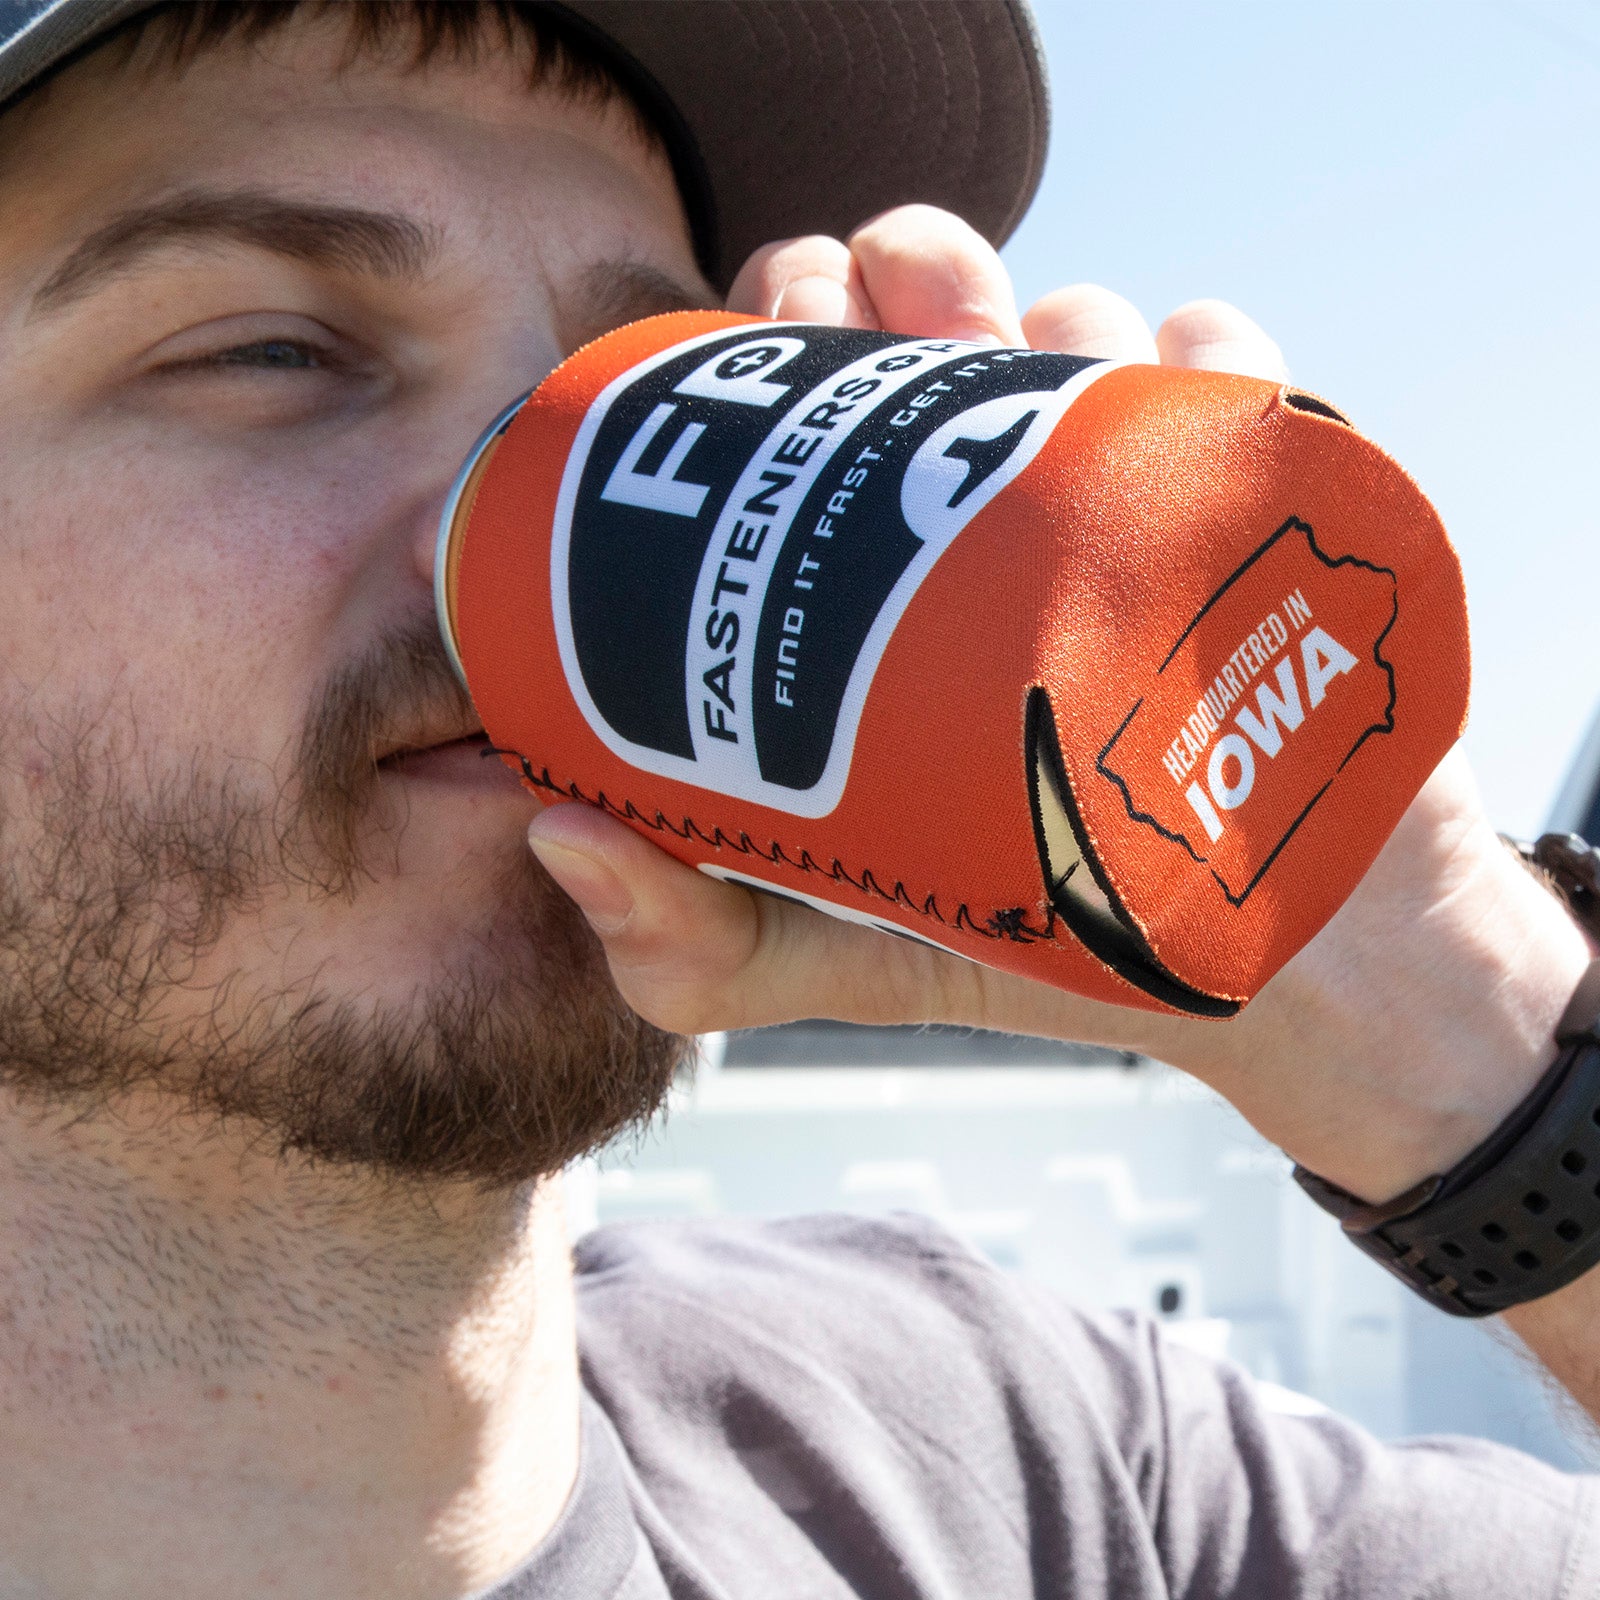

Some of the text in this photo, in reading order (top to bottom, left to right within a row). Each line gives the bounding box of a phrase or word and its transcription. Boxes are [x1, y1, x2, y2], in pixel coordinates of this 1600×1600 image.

[601, 336, 807, 518] FP
[775, 607, 804, 707] FIND
[796, 552, 820, 591] IT
[890, 380, 952, 427] GET
[954, 362, 989, 377] IT
[702, 378, 883, 744] FASTENERS
[1162, 589, 1313, 785] HEADQUARTERED IN
[1186, 625, 1359, 843] IOWA
